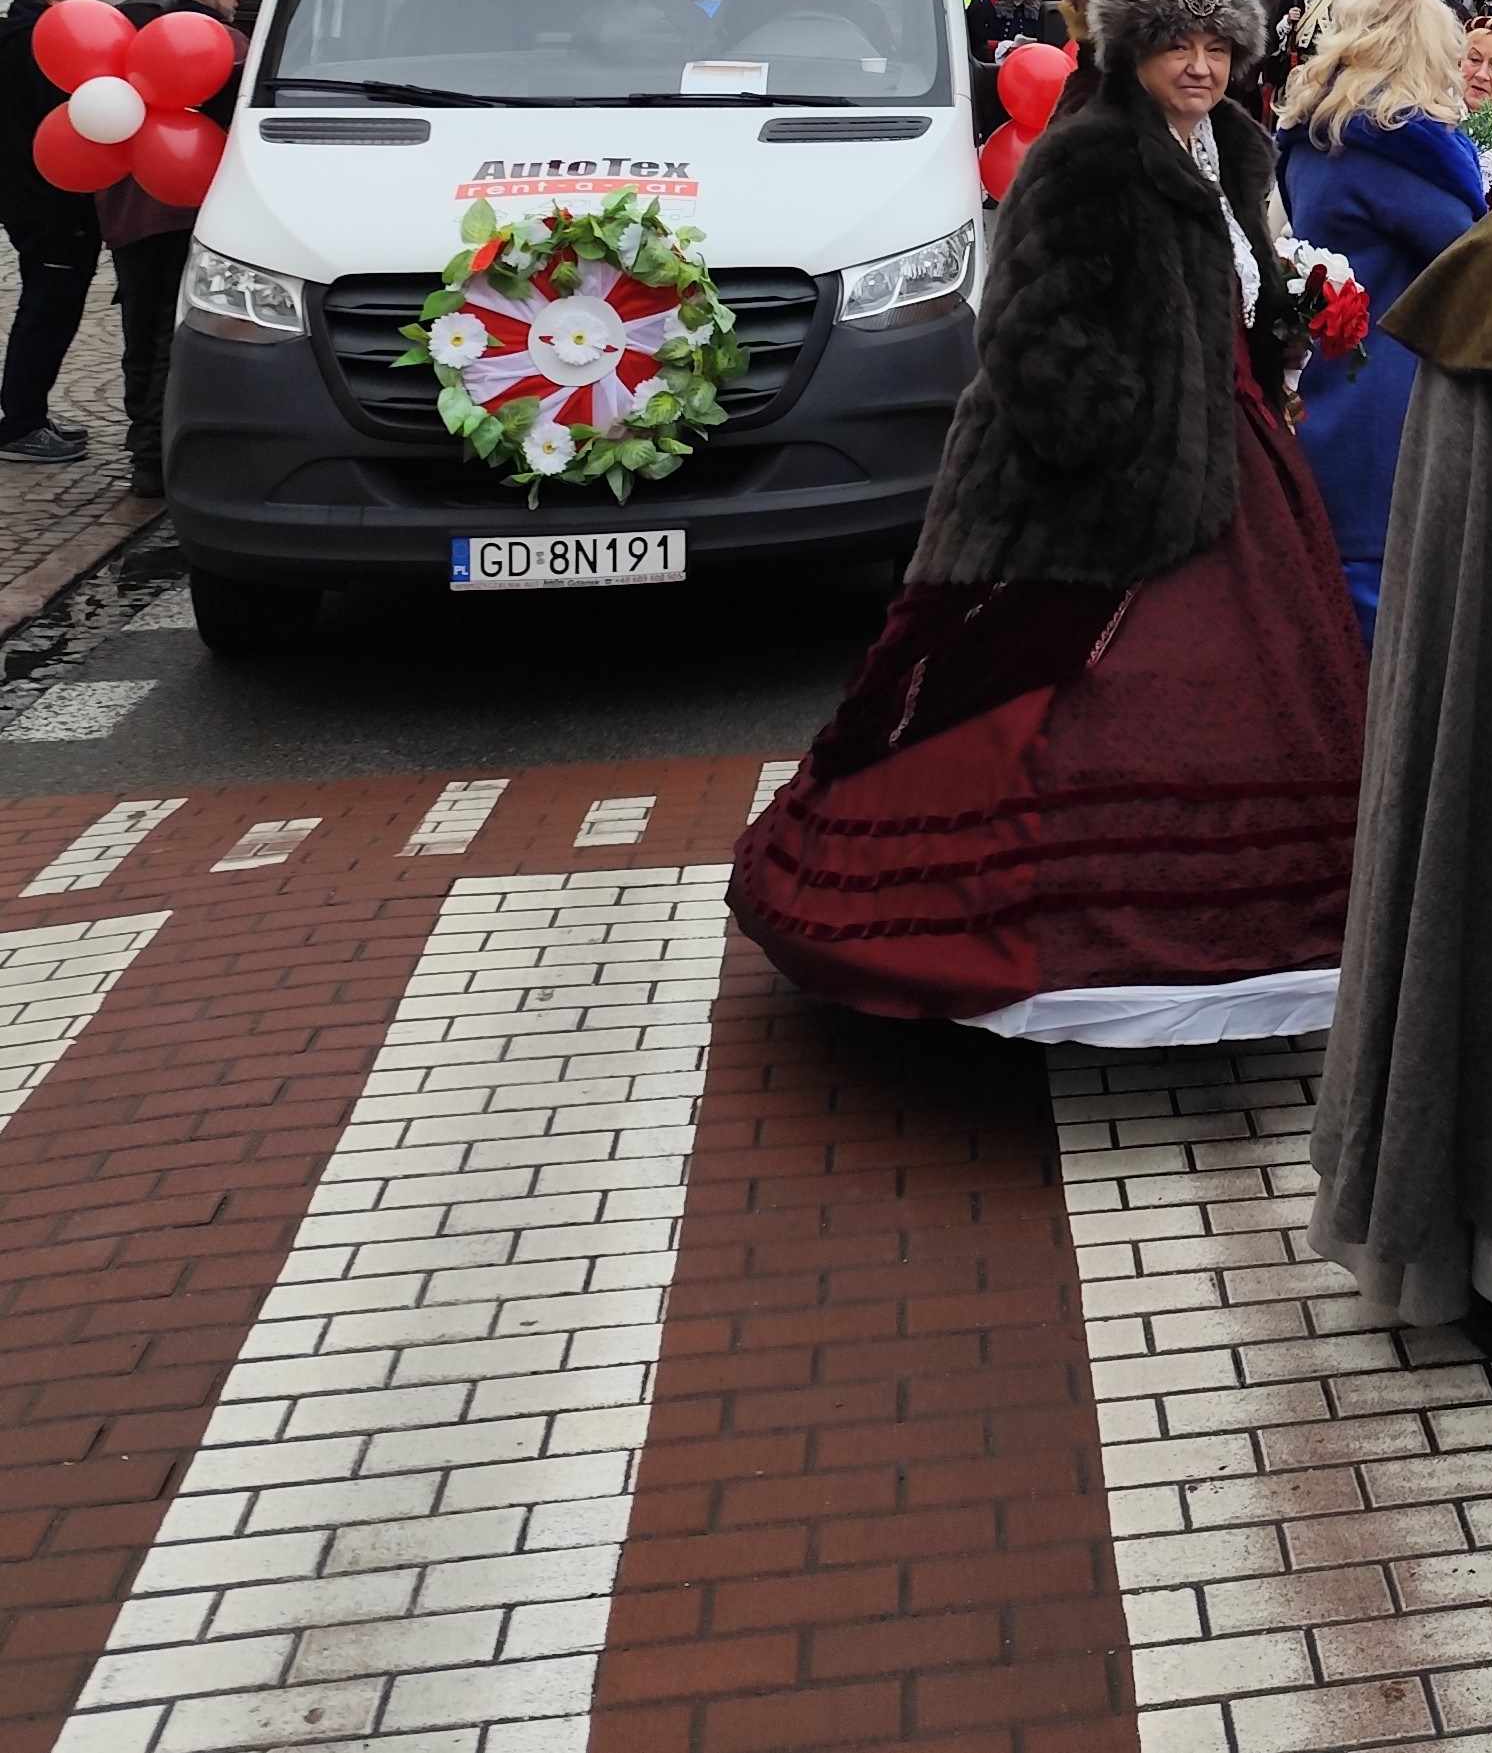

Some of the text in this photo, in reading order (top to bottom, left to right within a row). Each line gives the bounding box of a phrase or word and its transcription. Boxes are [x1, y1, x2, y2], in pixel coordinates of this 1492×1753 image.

[472, 157, 691, 181] AutoTex
[467, 181, 688, 197] rent-a-ar
[480, 534, 669, 577] GD 8N191
[453, 565, 469, 576] PL
